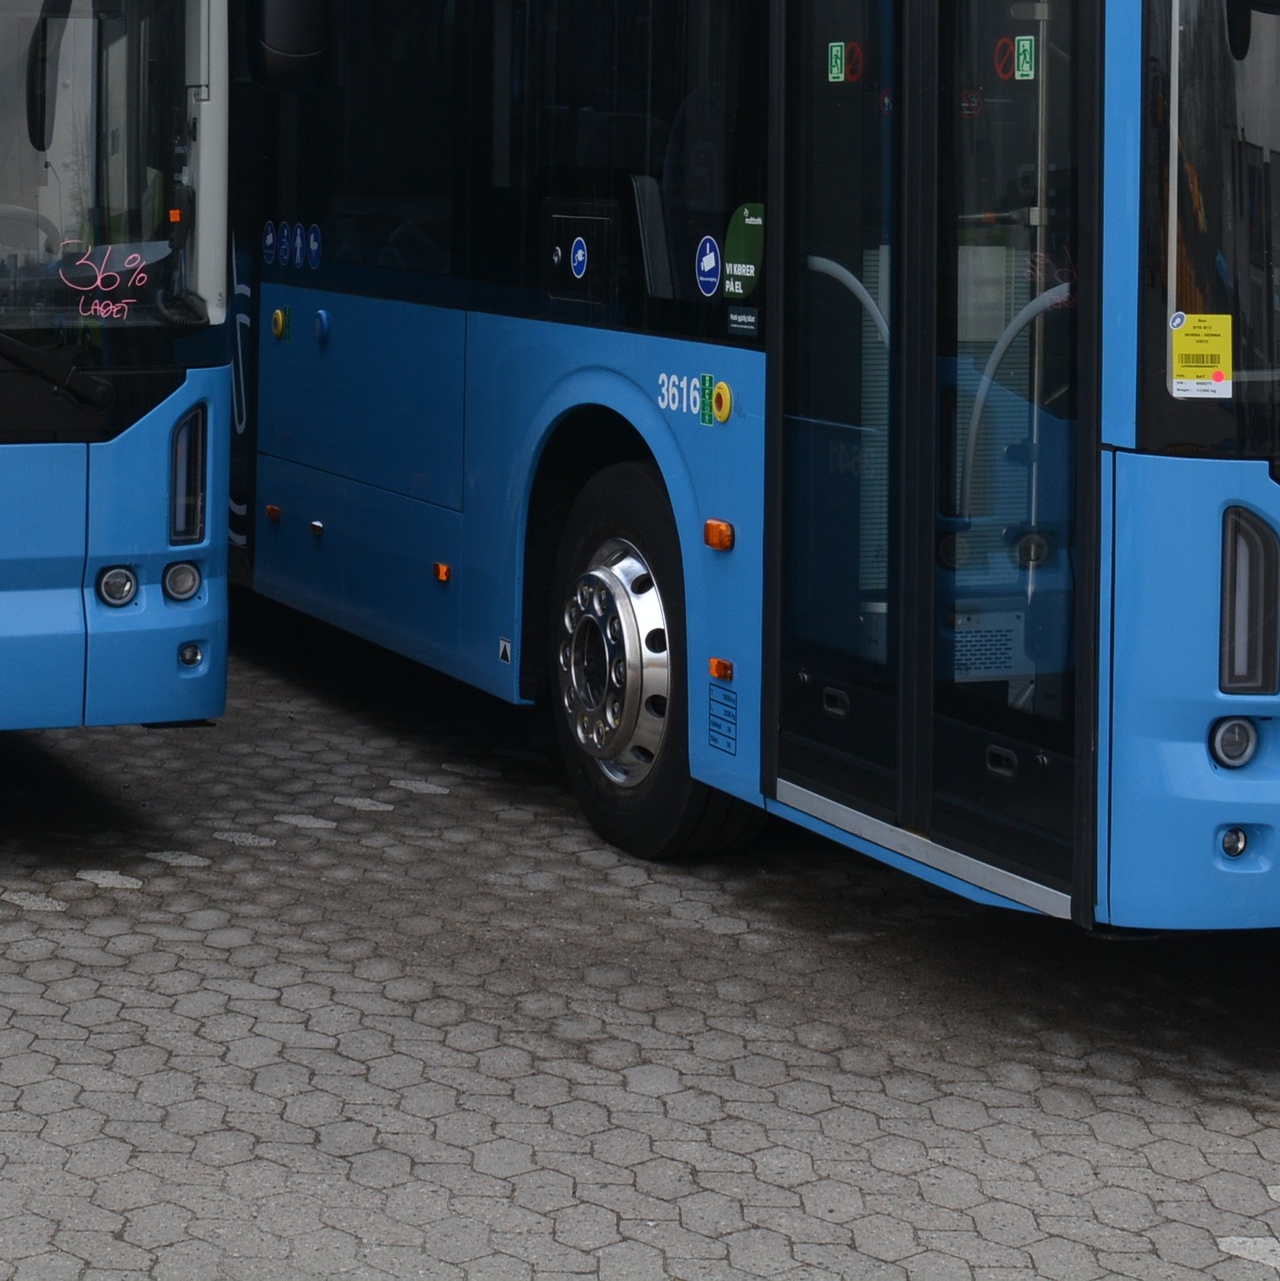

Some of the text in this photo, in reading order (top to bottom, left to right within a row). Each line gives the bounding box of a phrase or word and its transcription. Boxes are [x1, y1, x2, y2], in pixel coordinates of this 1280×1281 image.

[58, 239, 148, 291] 36%
[725, 263, 732, 275] VI
[725, 278, 734, 292] PÅ
[735, 281, 743, 293] EL
[658, 372, 700, 415] 3616
